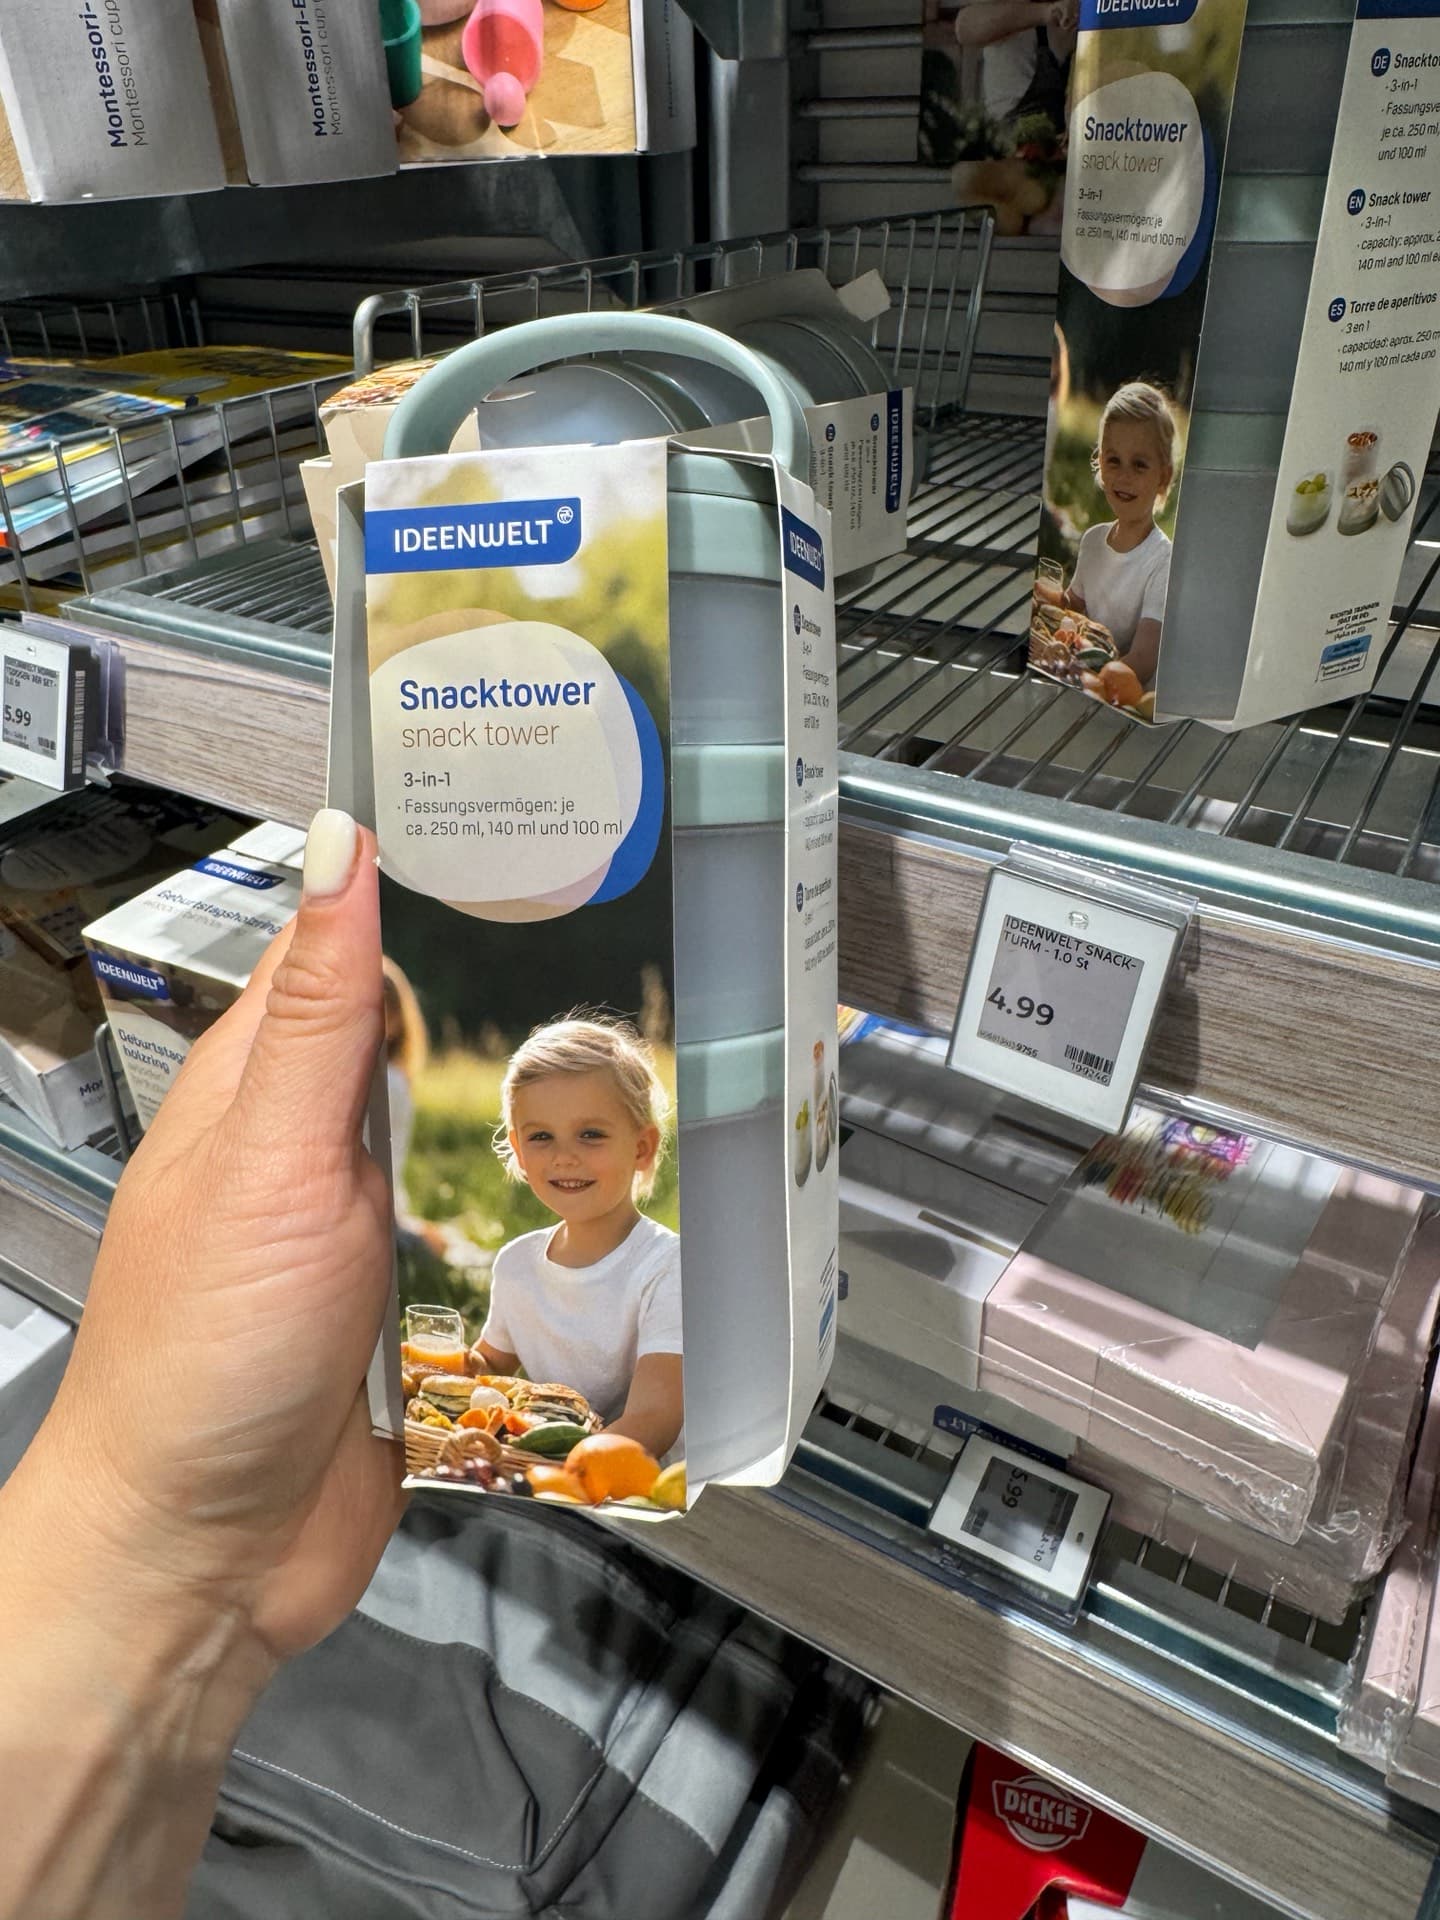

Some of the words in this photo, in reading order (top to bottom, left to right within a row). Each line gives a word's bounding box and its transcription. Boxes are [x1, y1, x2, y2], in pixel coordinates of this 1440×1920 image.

[104, 0, 123, 35] cup
[1374, 55, 1388, 69] DE
[1394, 53, 1440, 69] Snackto
[79, 2, 128, 147] Montessori-
[1390, 78, 1418, 92] 3-in-1
[111, 41, 149, 147] Montessori
[319, 46, 344, 136] Montessori
[1084, 116, 1188, 142] Snacktower
[1380, 127, 1391, 141] je
[1392, 126, 1406, 138] ca.
[1407, 123, 1426, 136] 250
[1081, 150, 1120, 171] snack
[1123, 152, 1164, 173] tower
[1378, 147, 1397, 160] und
[1398, 146, 1414, 159] 100
[1414, 144, 1427, 158] ml
[1349, 195, 1364, 209] EN
[1368, 191, 1401, 207] Snack
[1402, 191, 1432, 204] tower
[1365, 214, 1392, 229] 3-in-1
[1141, 232, 1158, 245] und
[1159, 233, 1174, 246] 100
[1361, 235, 1402, 251] capacity:
[1358, 257, 1374, 271] 140
[1374, 256, 1386, 269] ml
[1386, 254, 1404, 267] and
[1405, 251, 1420, 265] 100
[1420, 250, 1432, 263] ml
[1330, 303, 1344, 317] ES
[1350, 300, 1376, 314] Torre
[1377, 297, 1390, 310] de
[1390, 292, 1438, 310] aperitivos
[1345, 322, 1353, 334] 3
[1353, 322, 1365, 333] en
[1339, 360, 1354, 373] 140
[1354, 358, 1366, 371] ml
[1374, 355, 1389, 368] 100
[1389, 353, 1400, 366] ml
[890, 407, 899, 496] IDEENWELT
[394, 519, 553, 553] IDEENWELT
[400, 678, 596, 711] Snacktower
[4, 704, 32, 727] 5.99
[402, 721, 478, 748] snack
[484, 720, 560, 746] tower
[403, 771, 451, 788] 3-in-1
[405, 797, 558, 816] Fassungsvermögen:
[560, 797, 575, 815] je
[406, 822, 427, 836] ca.
[430, 821, 458, 835] 250
[462, 820, 485, 838] ml,
[489, 820, 513, 835] 140
[517, 820, 535, 836] ml
[540, 820, 569, 835] und
[572, 820, 599, 835] 100
[604, 819, 623, 835] ml
[1002, 930, 1041, 953] TURM
[1053, 948, 1073, 964] 1.0
[1076, 957, 1089, 971] St
[1005, 915, 1083, 951] IDEENWELT
[1086, 945, 1137, 971] SNACK-
[97, 960, 158, 990] IDEENWELT
[987, 986, 1055, 1027] 4.99
[122, 1044, 170, 1075] holzring
[1001, 1467, 1028, 1509] 5.99
